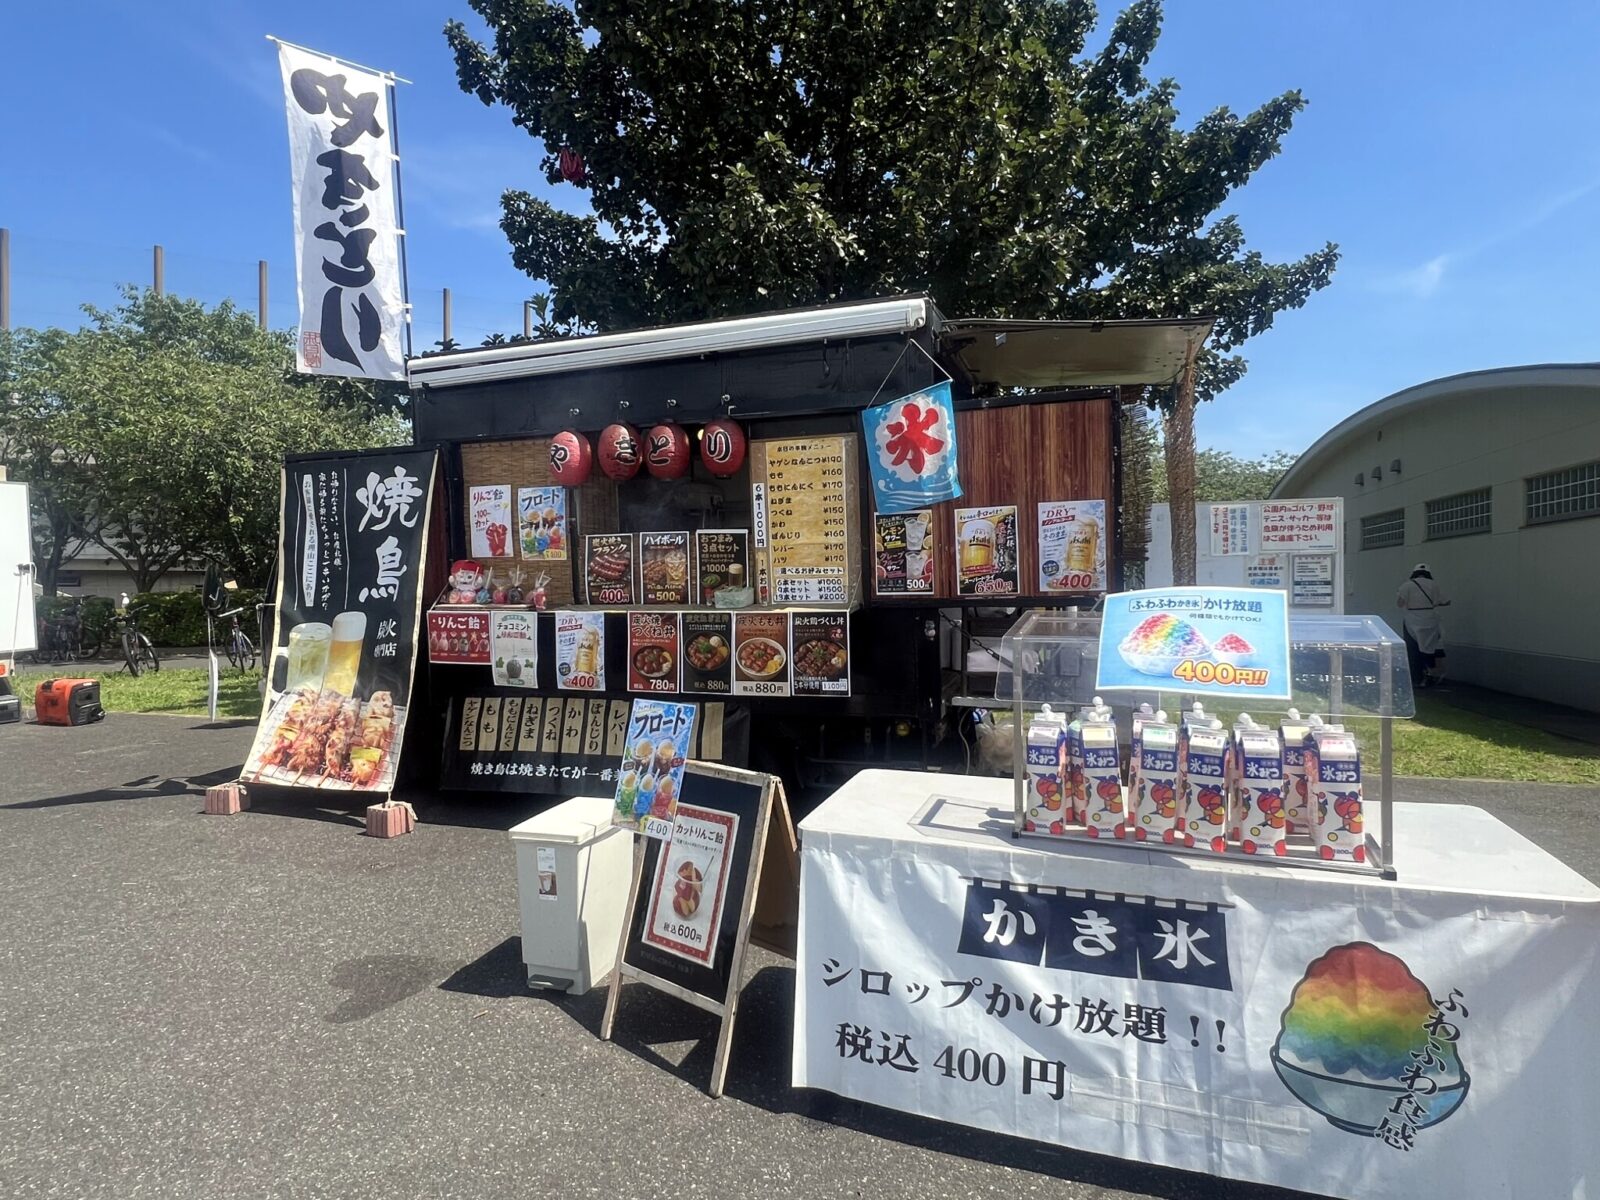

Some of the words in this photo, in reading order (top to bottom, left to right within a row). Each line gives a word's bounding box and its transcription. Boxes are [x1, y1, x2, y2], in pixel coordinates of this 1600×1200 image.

[886, 403, 944, 475] 氷
[769, 472, 784, 480] もも
[769, 482, 814, 492] ももにんにく
[473, 489, 504, 506] りんご飴
[521, 489, 559, 511] フロート
[1046, 508, 1070, 518] DRY
[771, 521, 786, 529] かわ
[881, 526, 905, 537] レモン
[356, 465, 423, 602] 焼鳥
[644, 534, 685, 545] ハイボール
[700, 534, 733, 543] おつまみ
[593, 544, 628, 556] フランク
[701, 543, 740, 553] 3点セット
[773, 544, 795, 553] レバー
[1203, 598, 1263, 613] かけ放題
[438, 616, 480, 629] りんご飴
[496, 622, 532, 631] チョコミント
[632, 625, 676, 639] つくね丼
[649, 679, 676, 691] 780円
[755, 682, 784, 693] 880円
[482, 704, 497, 734] もも
[522, 703, 540, 740] ねぎま
[544, 705, 560, 741] つくね
[565, 707, 581, 738] かわ
[589, 702, 604, 752] ぼんじり
[632, 705, 686, 740] フロート
[609, 709, 626, 746] レバー
[1028, 749, 1057, 765] 氷みつ
[1086, 752, 1116, 768] 氷みつ
[1143, 755, 1175, 770] 氷みつ
[1190, 757, 1222, 774] 氷みつ
[1246, 761, 1280, 777] 氷みつ
[1321, 764, 1358, 781] 氷みつ
[675, 823, 724, 845] カットりんご飴
[677, 923, 702, 944] 600円
[982, 898, 1218, 970] かき氷
